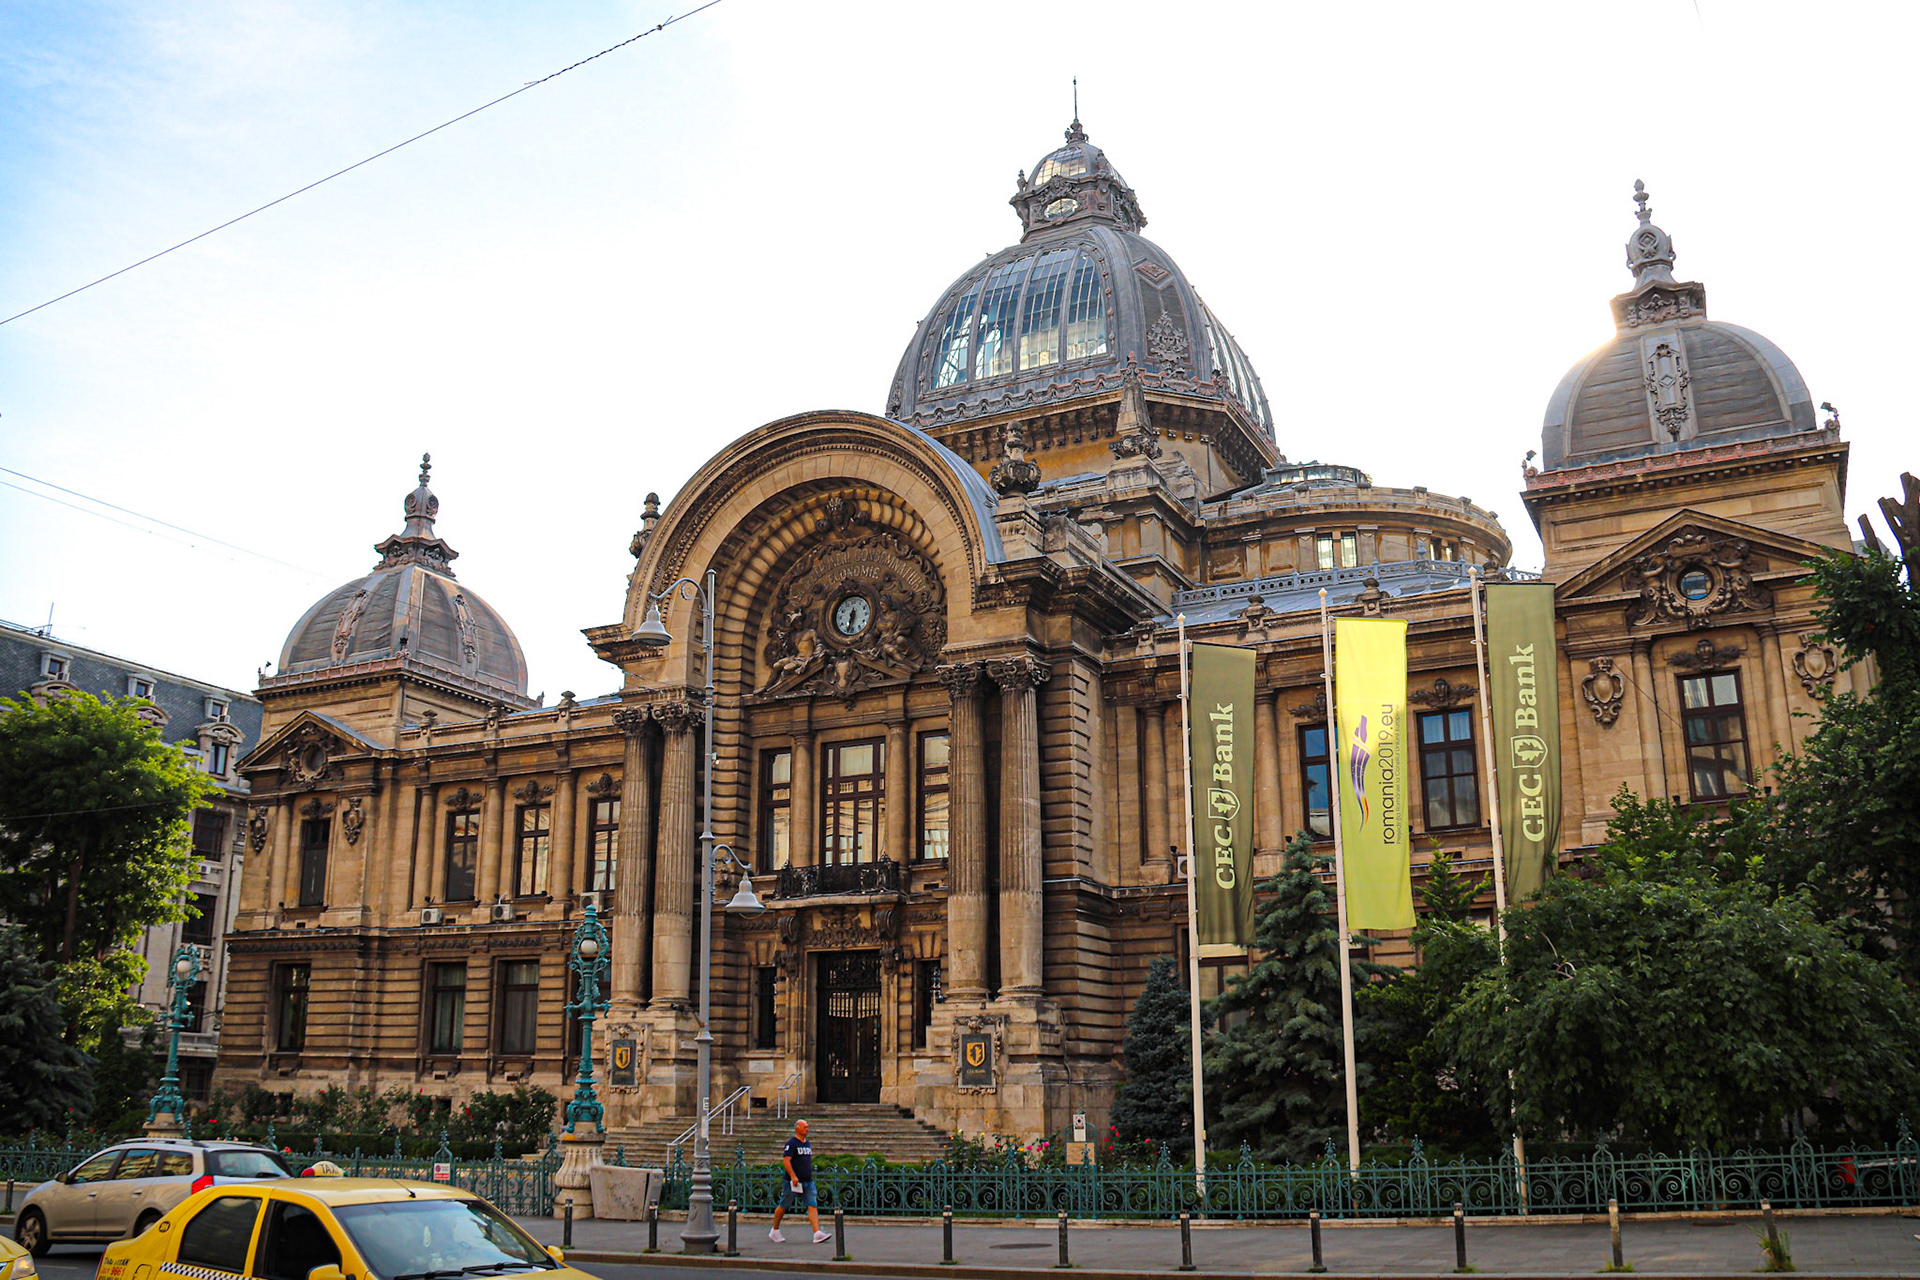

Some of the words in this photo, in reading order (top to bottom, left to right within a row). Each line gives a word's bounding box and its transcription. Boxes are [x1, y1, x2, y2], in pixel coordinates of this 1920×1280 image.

[1510, 642, 1535, 729] Bank
[1209, 702, 1234, 784] Bank
[1378, 704, 1394, 845] romania2019.eu
[1522, 774, 1545, 842] CEC
[1215, 824, 1236, 890] CEC
